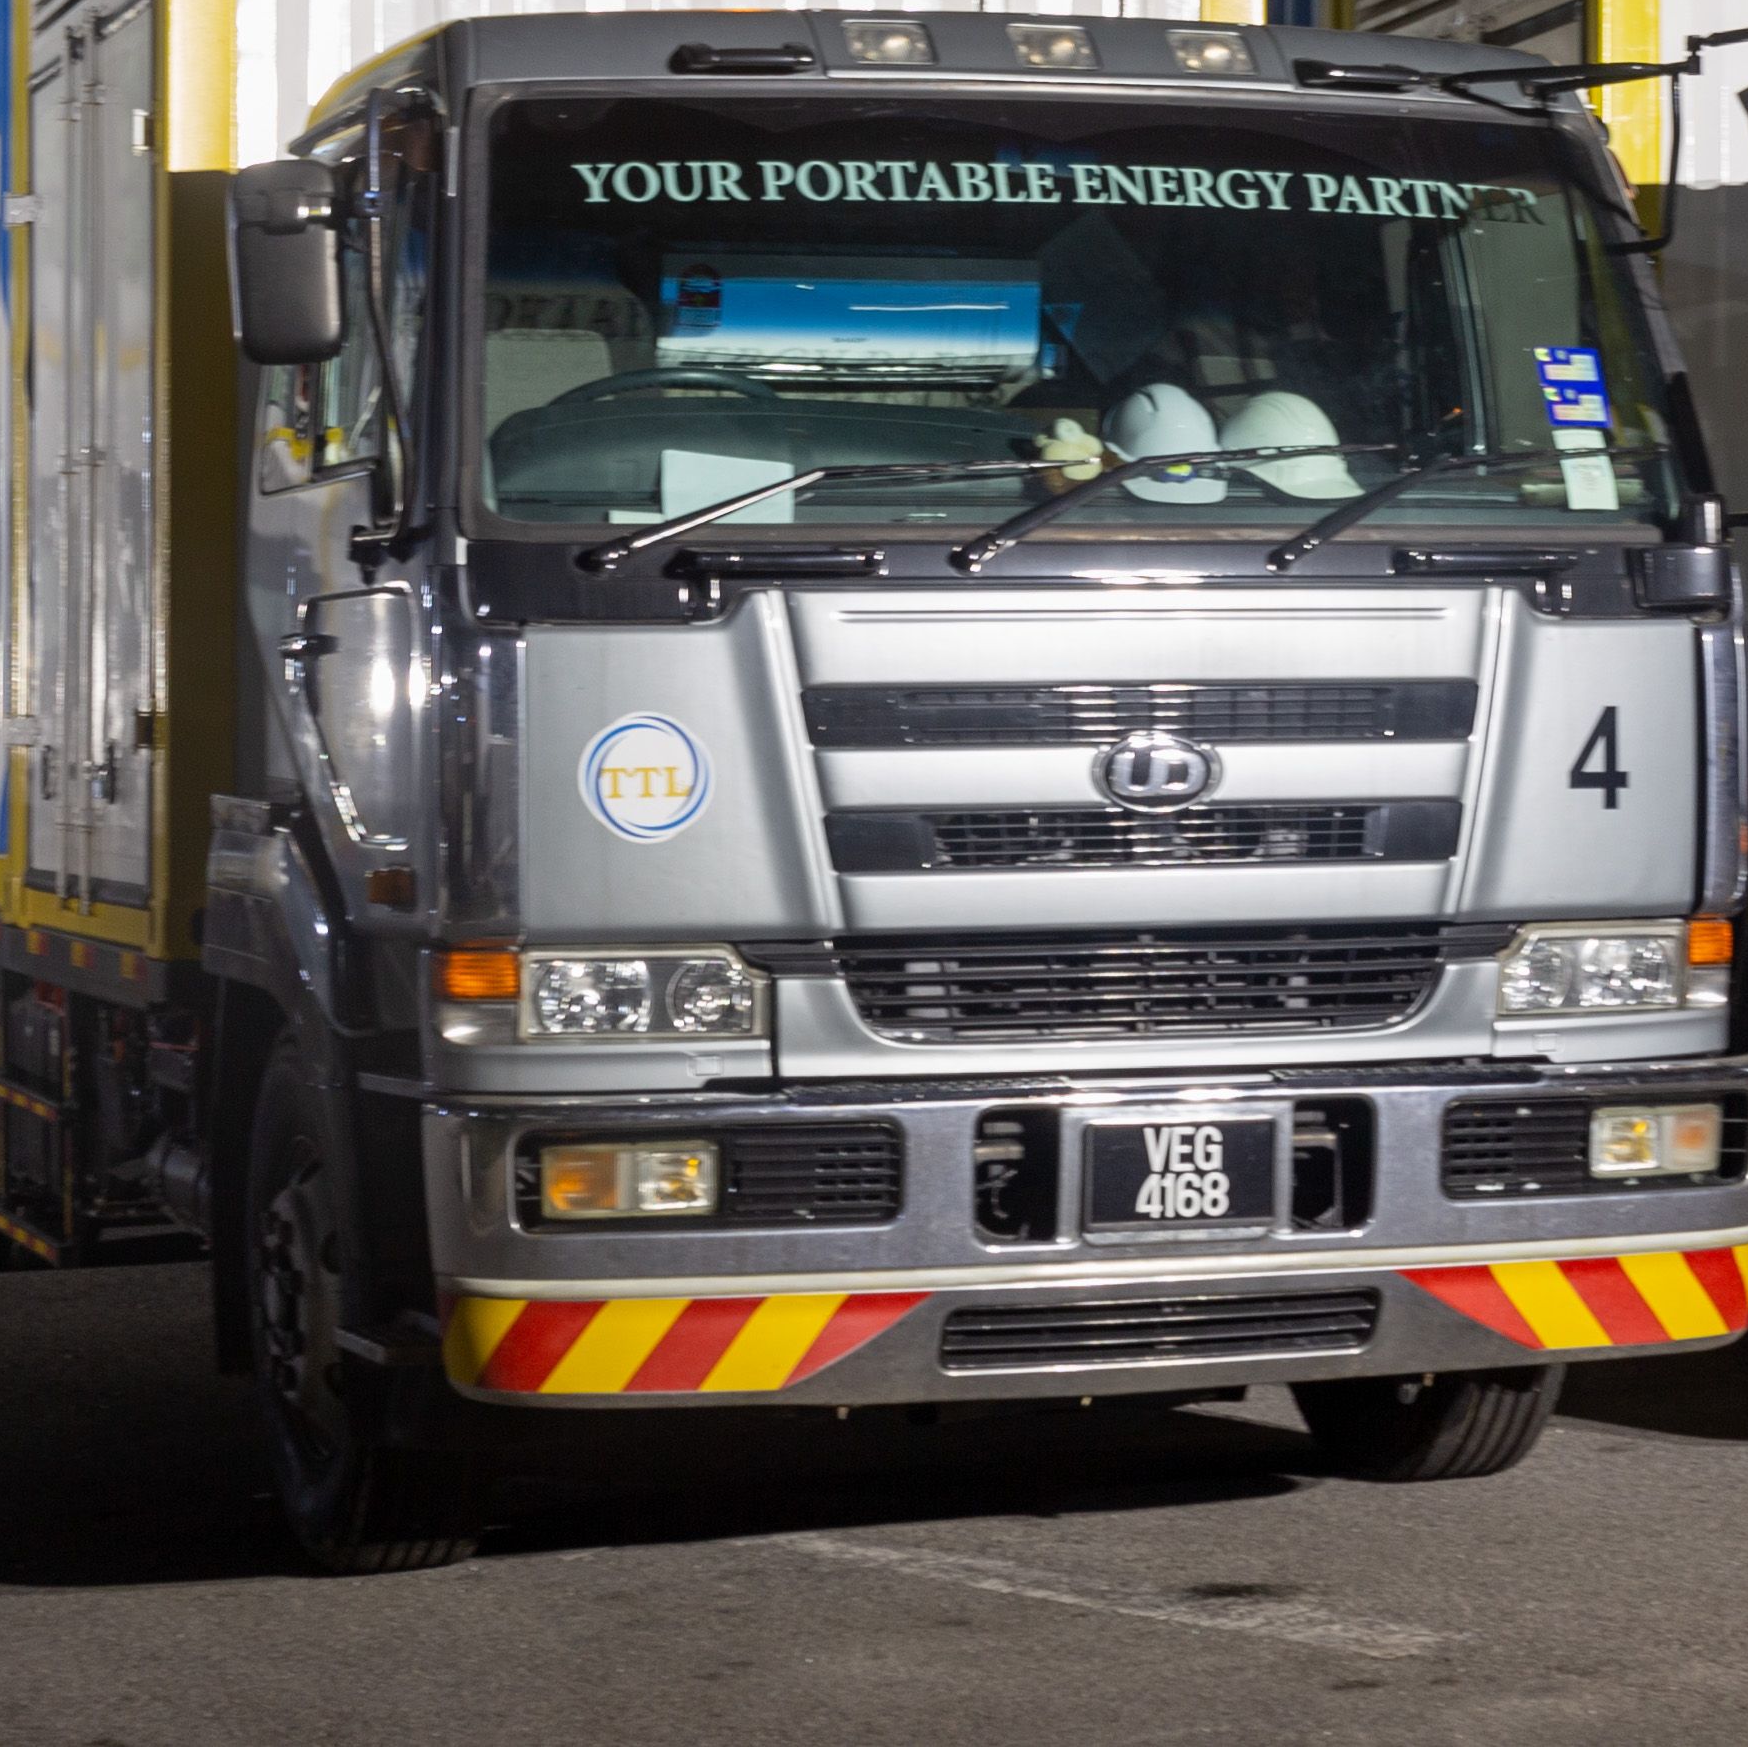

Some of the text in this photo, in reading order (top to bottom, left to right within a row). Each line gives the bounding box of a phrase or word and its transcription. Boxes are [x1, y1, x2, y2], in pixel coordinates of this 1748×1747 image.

[572, 160, 1544, 226] YOUR PORTABLE ENERGY PARTNER
[1569, 705, 1629, 810] 4
[601, 766, 693, 799] TTL
[1144, 1127, 1223, 1168] VEG
[1135, 1171, 1230, 1219] 4168
